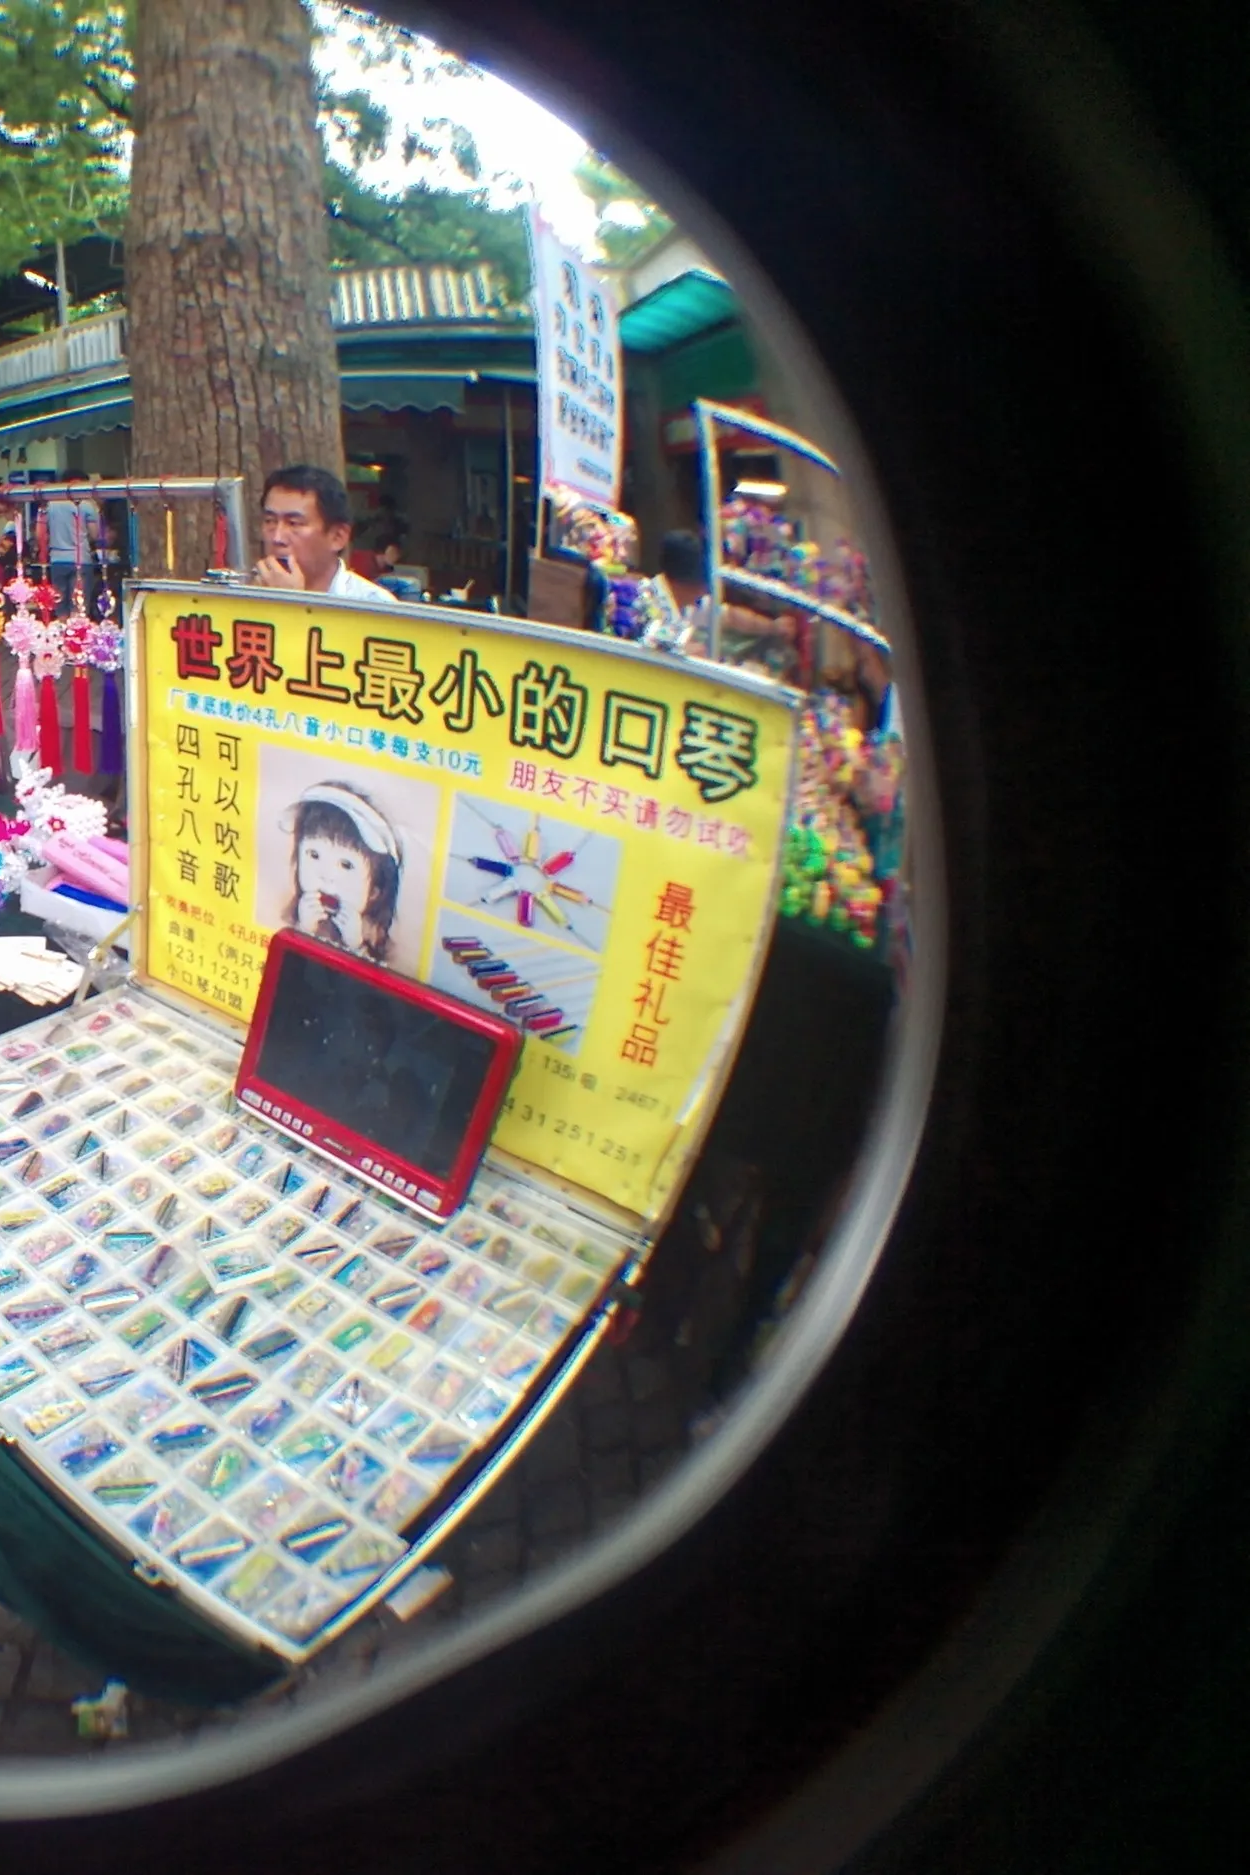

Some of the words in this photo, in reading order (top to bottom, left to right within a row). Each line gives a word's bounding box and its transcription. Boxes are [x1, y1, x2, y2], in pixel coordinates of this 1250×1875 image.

[170, 613, 759, 803] 世界上最小的口琴
[176, 724, 201, 885] 四孔八音
[213, 731, 241, 904] 可以吹歌
[619, 881, 696, 1070] 最佳礼品
